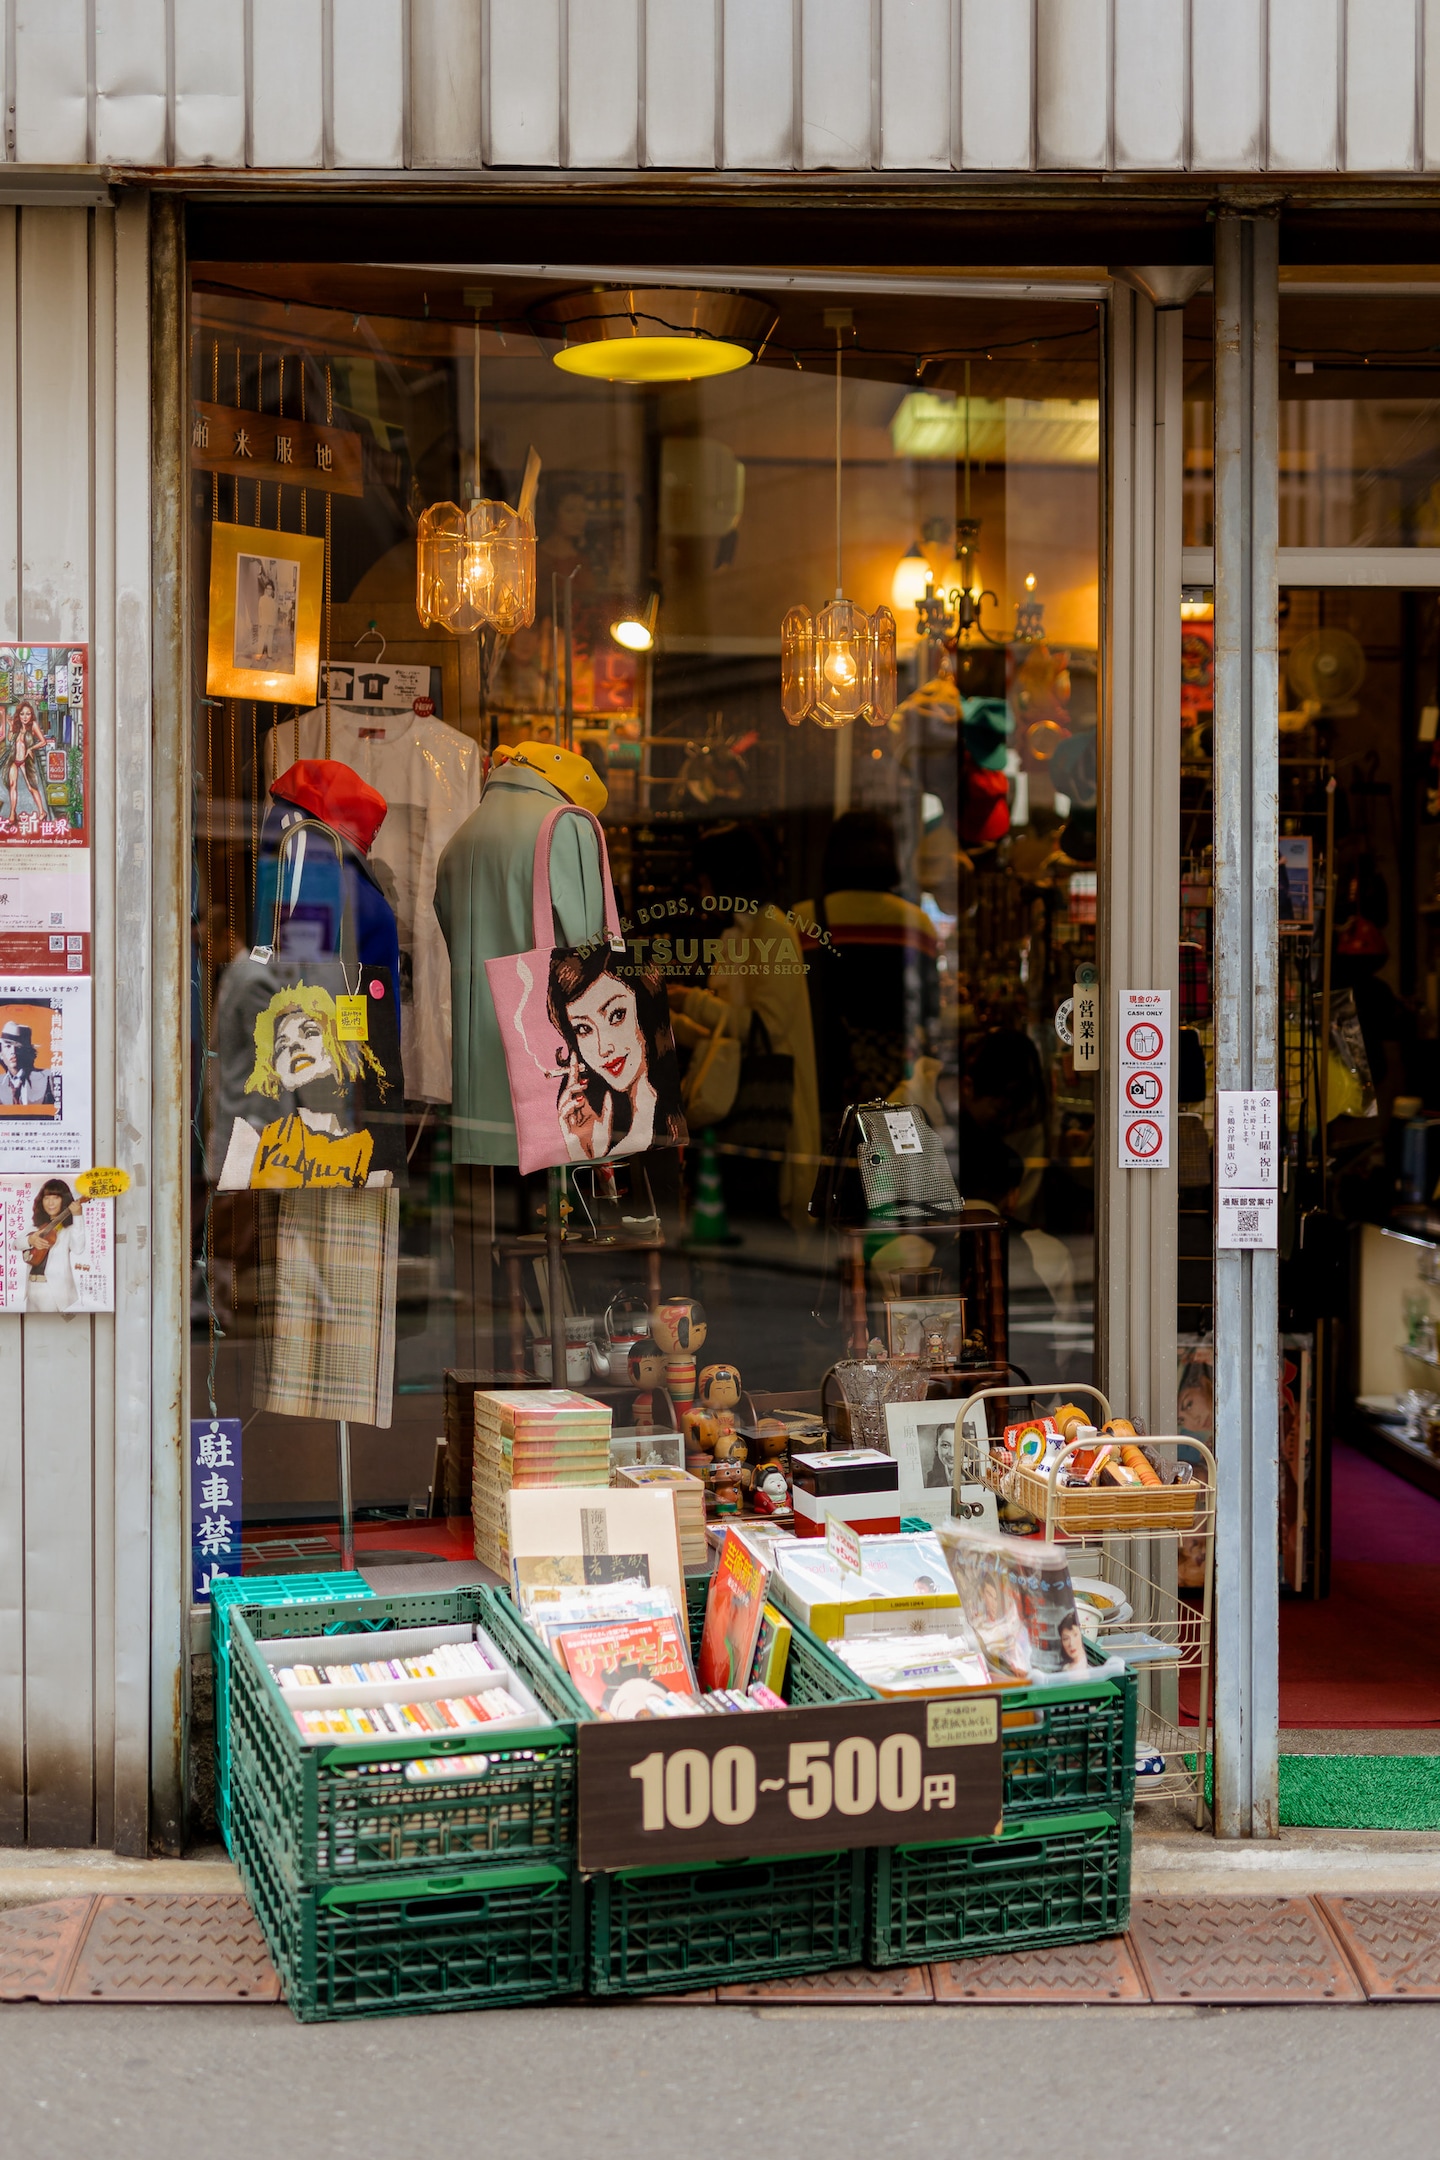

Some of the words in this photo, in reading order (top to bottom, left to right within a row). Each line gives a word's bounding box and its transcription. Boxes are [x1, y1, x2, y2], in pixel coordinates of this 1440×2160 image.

[192, 420, 333, 472] 舶来服地
[576, 925, 614, 960] BITS
[619, 916, 635, 933] &
[637, 897, 695, 925] BOBS,
[701, 895, 759, 915] ODDS
[764, 904, 778, 921] &
[616, 964, 692, 977] FORMERLY
[695, 964, 706, 976] A
[707, 964, 770, 977] TAILOR'S
[773, 964, 811, 976] SHOP
[627, 938, 799, 964] TSURUYA
[1129, 995, 1161, 1004] 現金のみ
[1079, 999, 1096, 1061] 営業中
[1259, 1096, 1272, 1182] 金・土・日曜・祝日の
[16, 1189, 25, 1231] 明かされる
[1222, 1198, 1274, 1206] 通販部営業中
[8, 1205, 17, 1302] 泣き笑い青春記！
[196, 1433, 235, 1595] 駐車禁止
[575, 1637, 678, 1678] サザエさん
[648, 1661, 684, 1677] 2016
